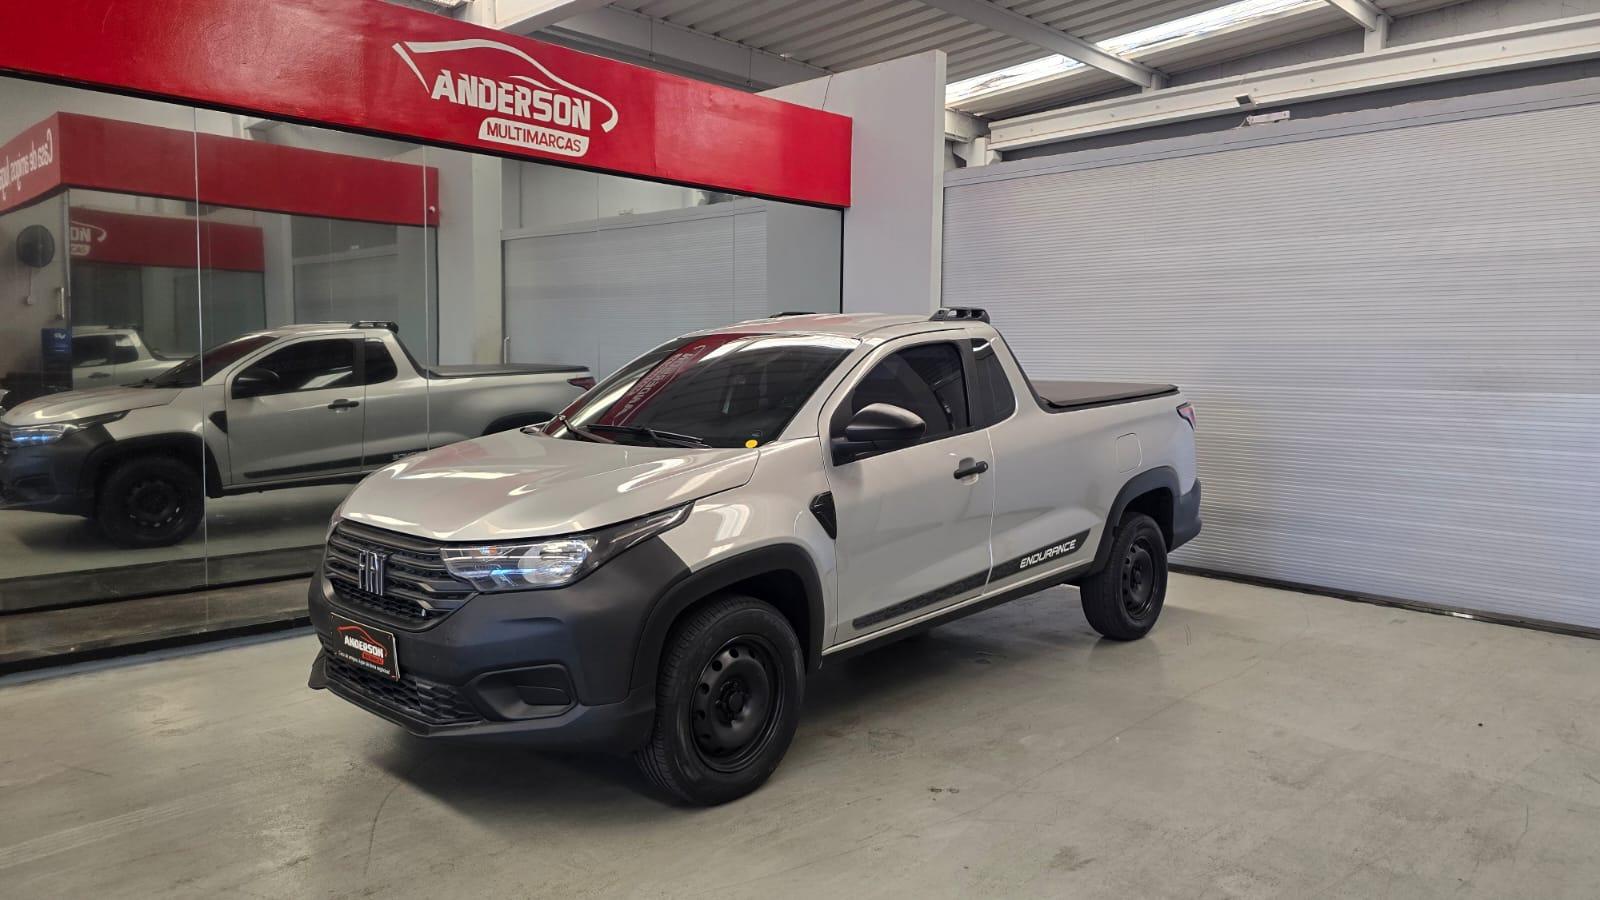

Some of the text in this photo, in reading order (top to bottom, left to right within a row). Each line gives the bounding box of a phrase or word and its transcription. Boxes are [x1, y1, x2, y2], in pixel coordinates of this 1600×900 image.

[431, 69, 591, 131] ANDERSON
[486, 121, 582, 153] MULTIMARCAS
[1020, 539, 1077, 568] ENDURANCE
[358, 548, 387, 596] FIAT
[344, 634, 384, 658] ANDERSON
